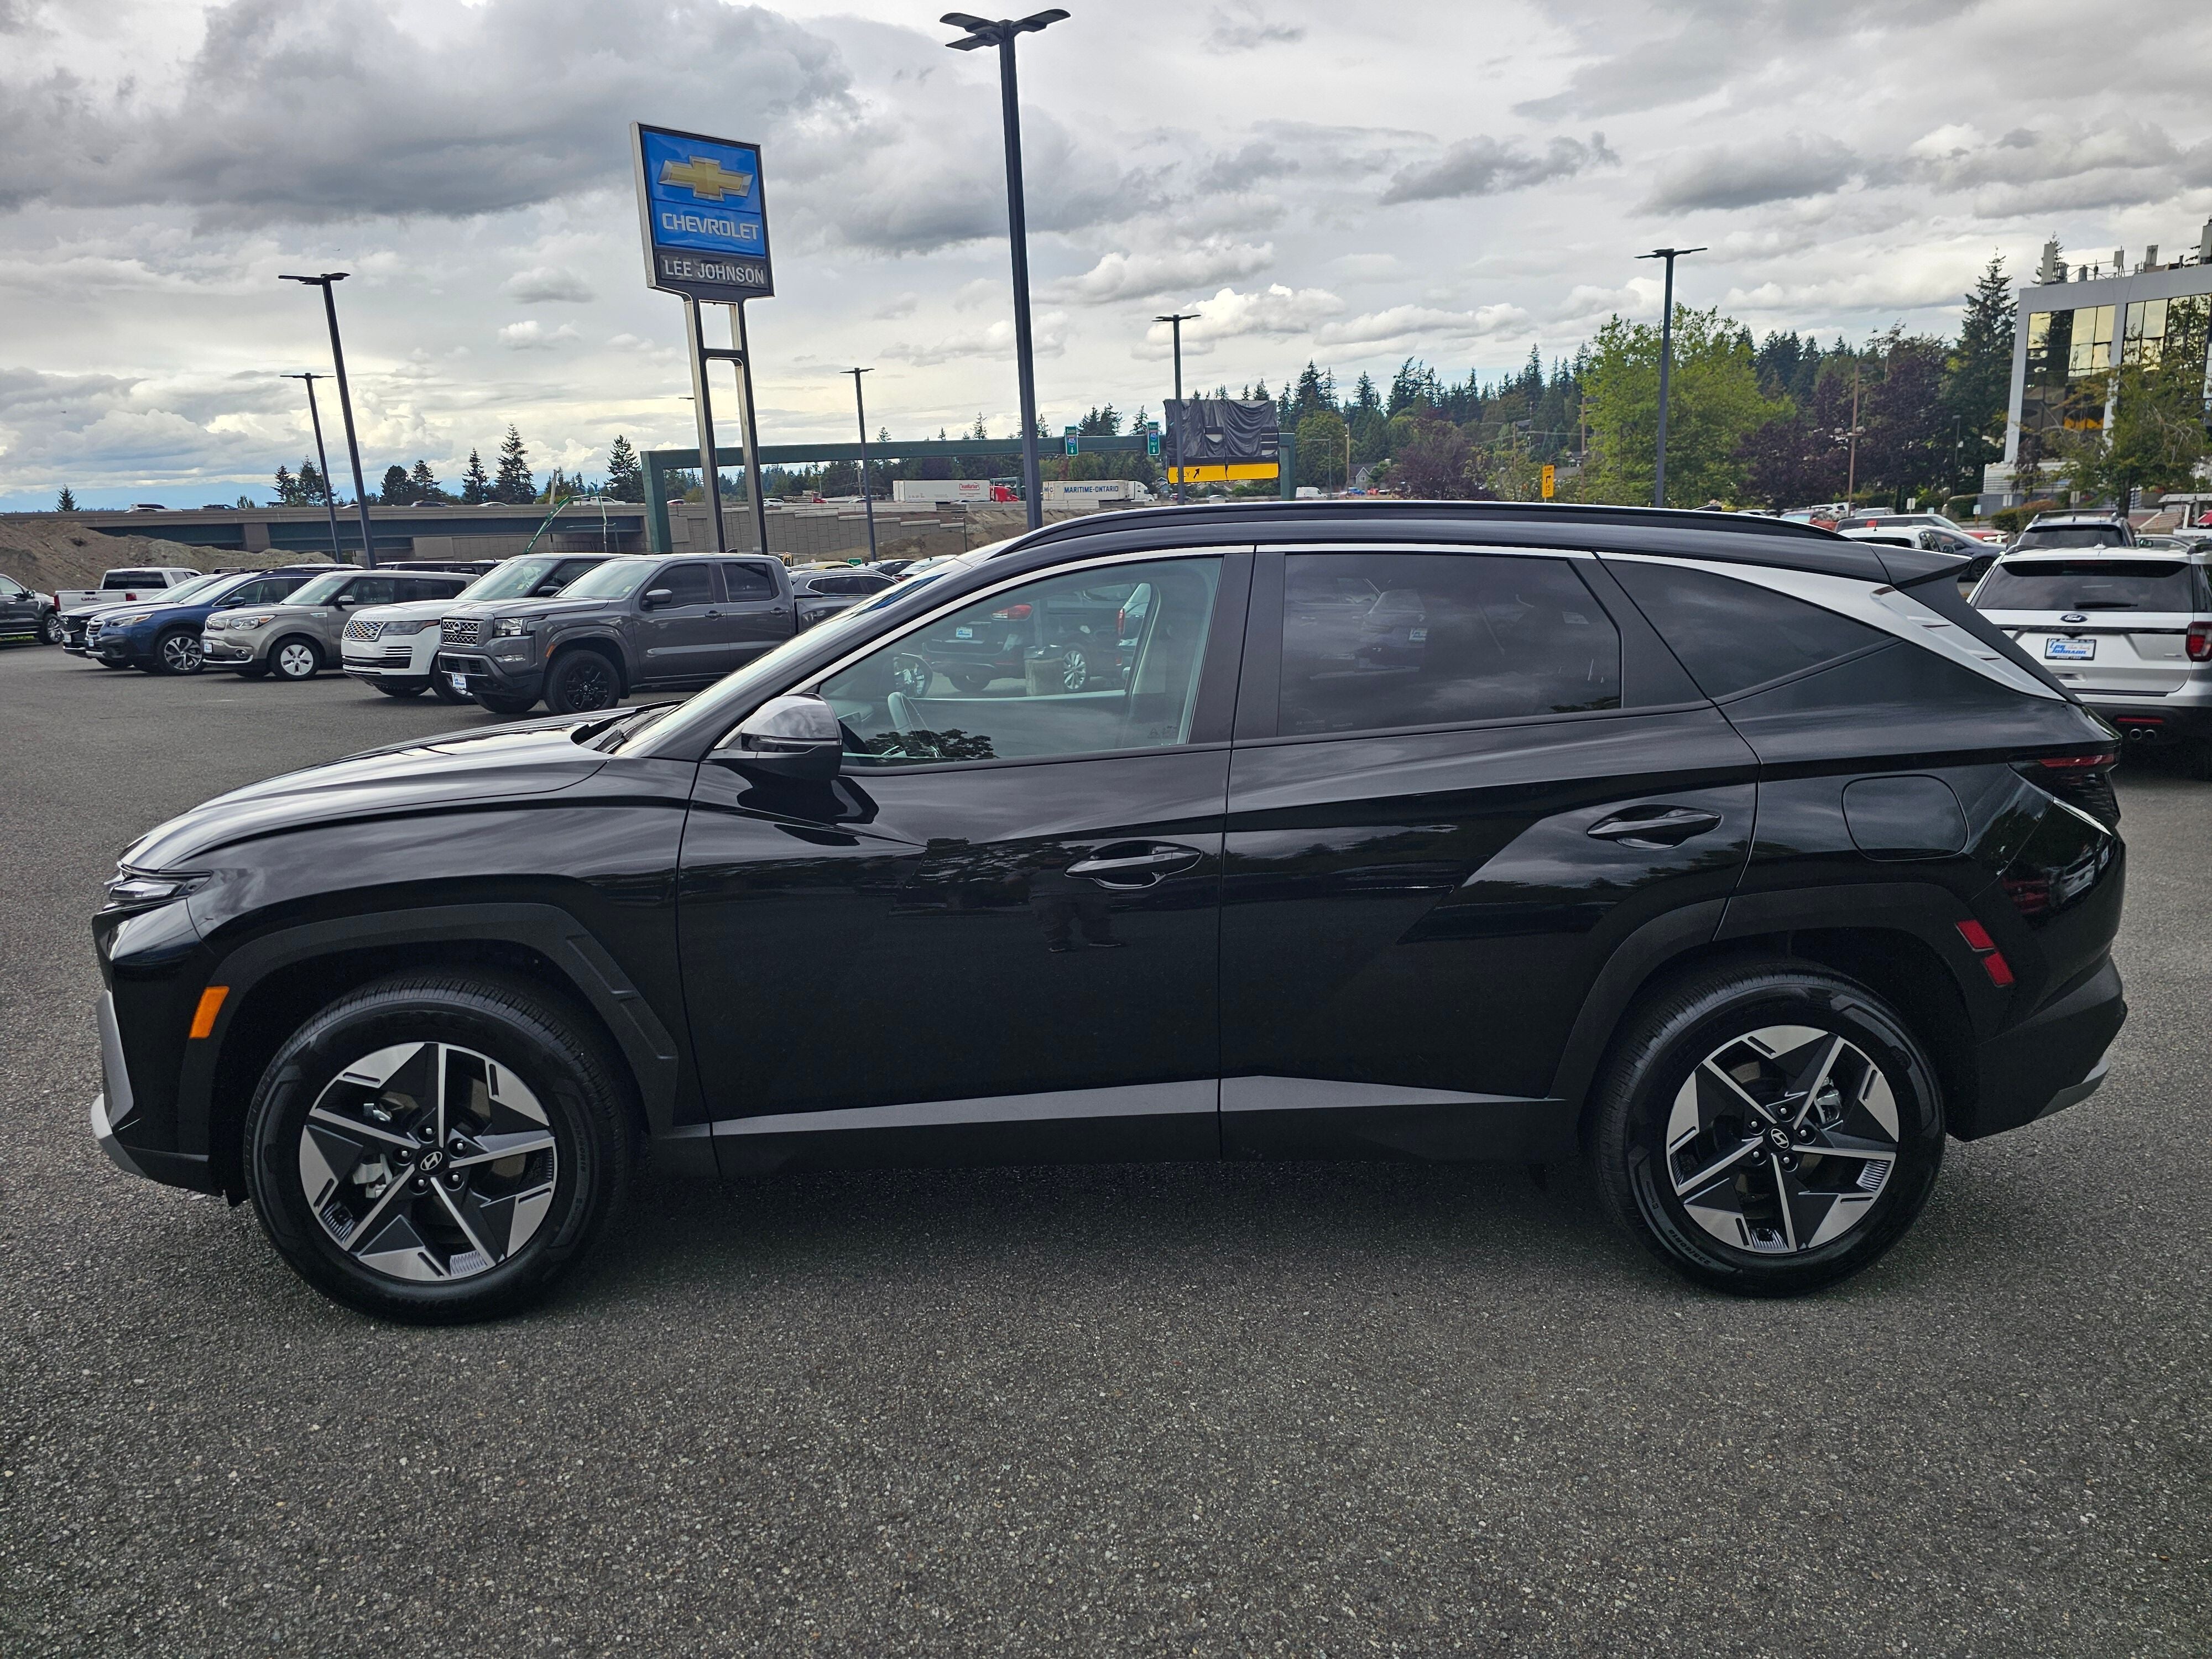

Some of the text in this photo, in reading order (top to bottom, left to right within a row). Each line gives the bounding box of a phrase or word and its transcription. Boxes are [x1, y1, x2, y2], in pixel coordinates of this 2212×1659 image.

[662, 213, 759, 240] CHEVROLET
[665, 259, 764, 284] LEE JOHNSON
